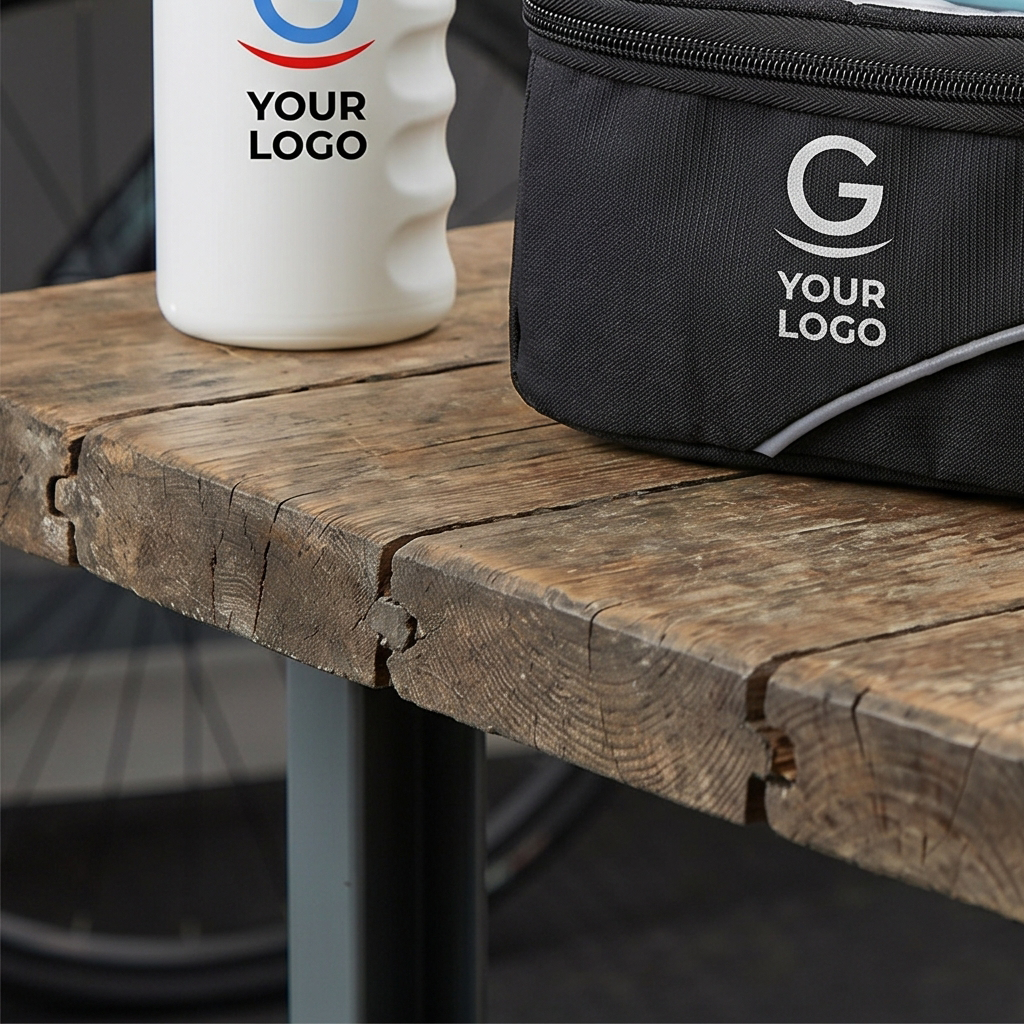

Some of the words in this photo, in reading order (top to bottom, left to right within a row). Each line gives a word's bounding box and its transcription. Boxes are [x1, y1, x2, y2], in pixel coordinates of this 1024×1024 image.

[246, 91, 366, 121] YOUR
[250, 130, 367, 160] LOGO
[787, 135, 884, 236] G
[777, 270, 886, 309] YOUR
[778, 309, 887, 347] LOGO
